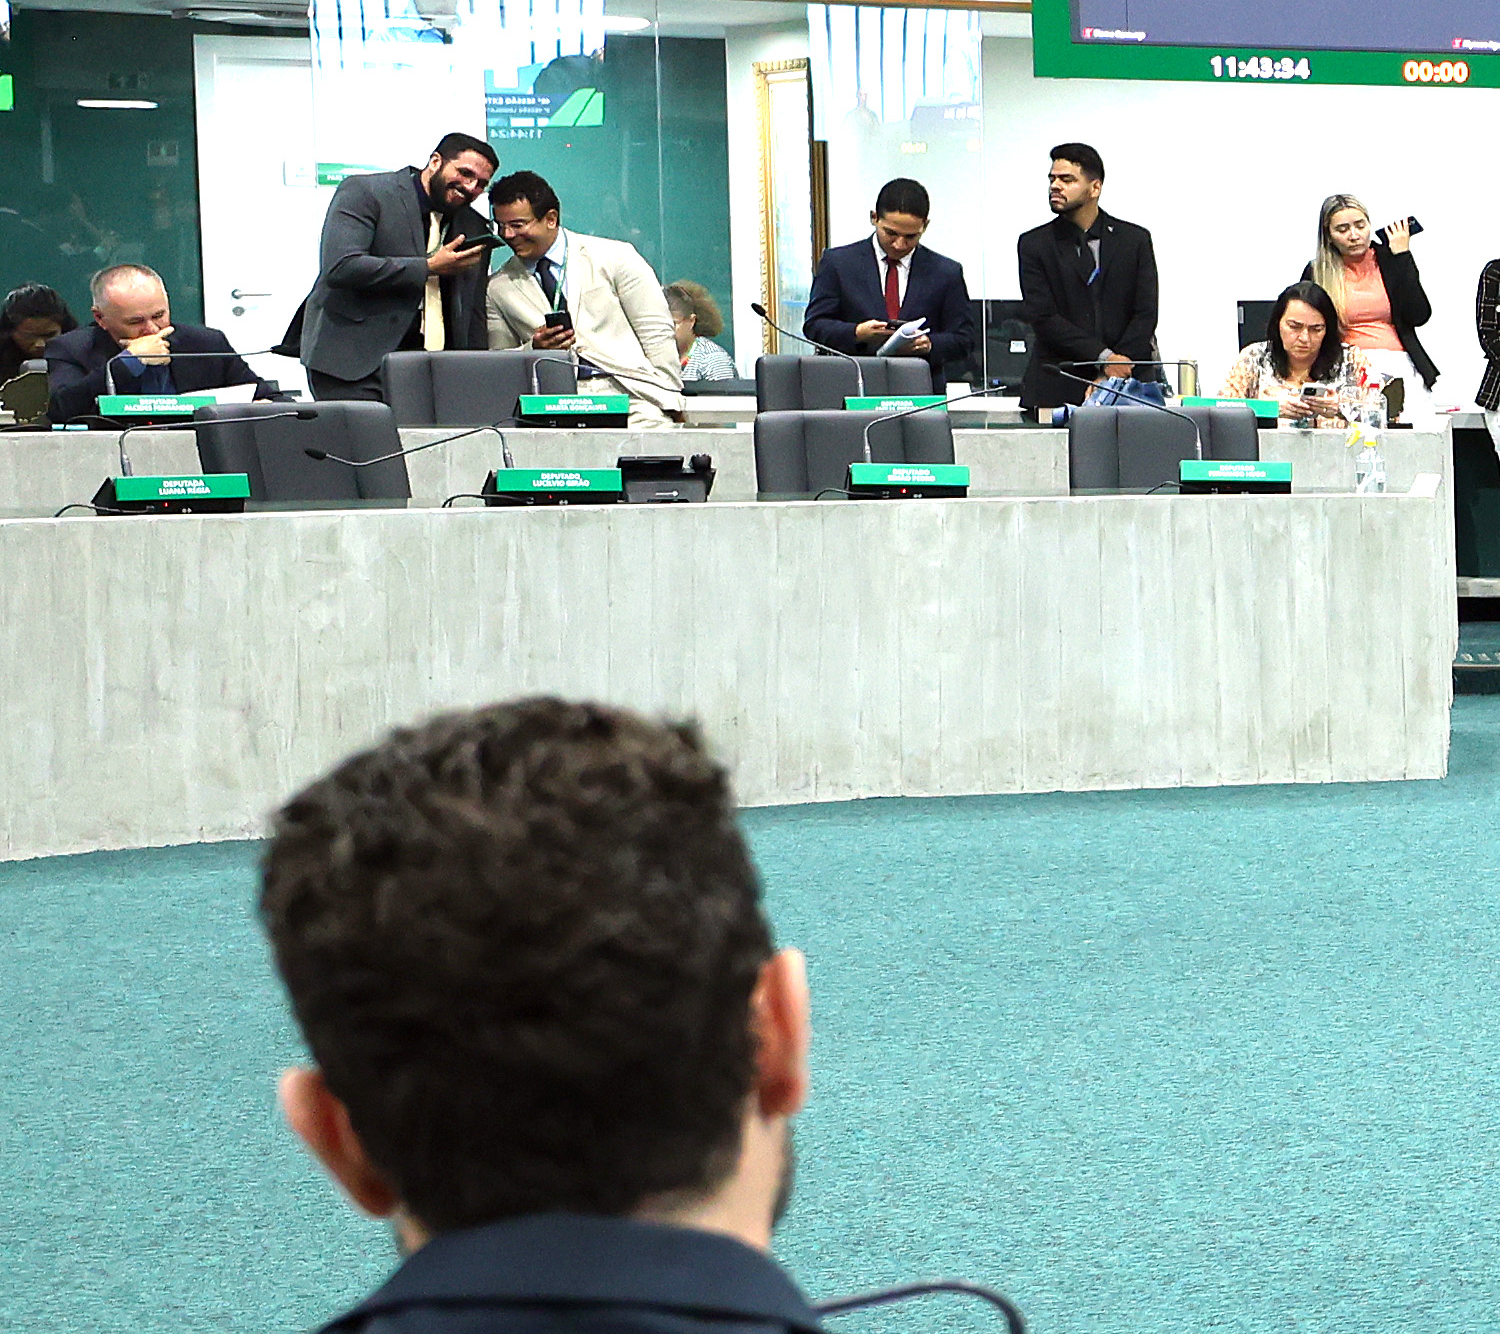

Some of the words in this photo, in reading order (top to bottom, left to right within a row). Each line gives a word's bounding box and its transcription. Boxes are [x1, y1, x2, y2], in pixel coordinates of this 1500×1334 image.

[1209, 55, 1311, 80] 11:43:34
[1402, 58, 1470, 84] 00:00
[158, 487, 186, 495] LUANA
